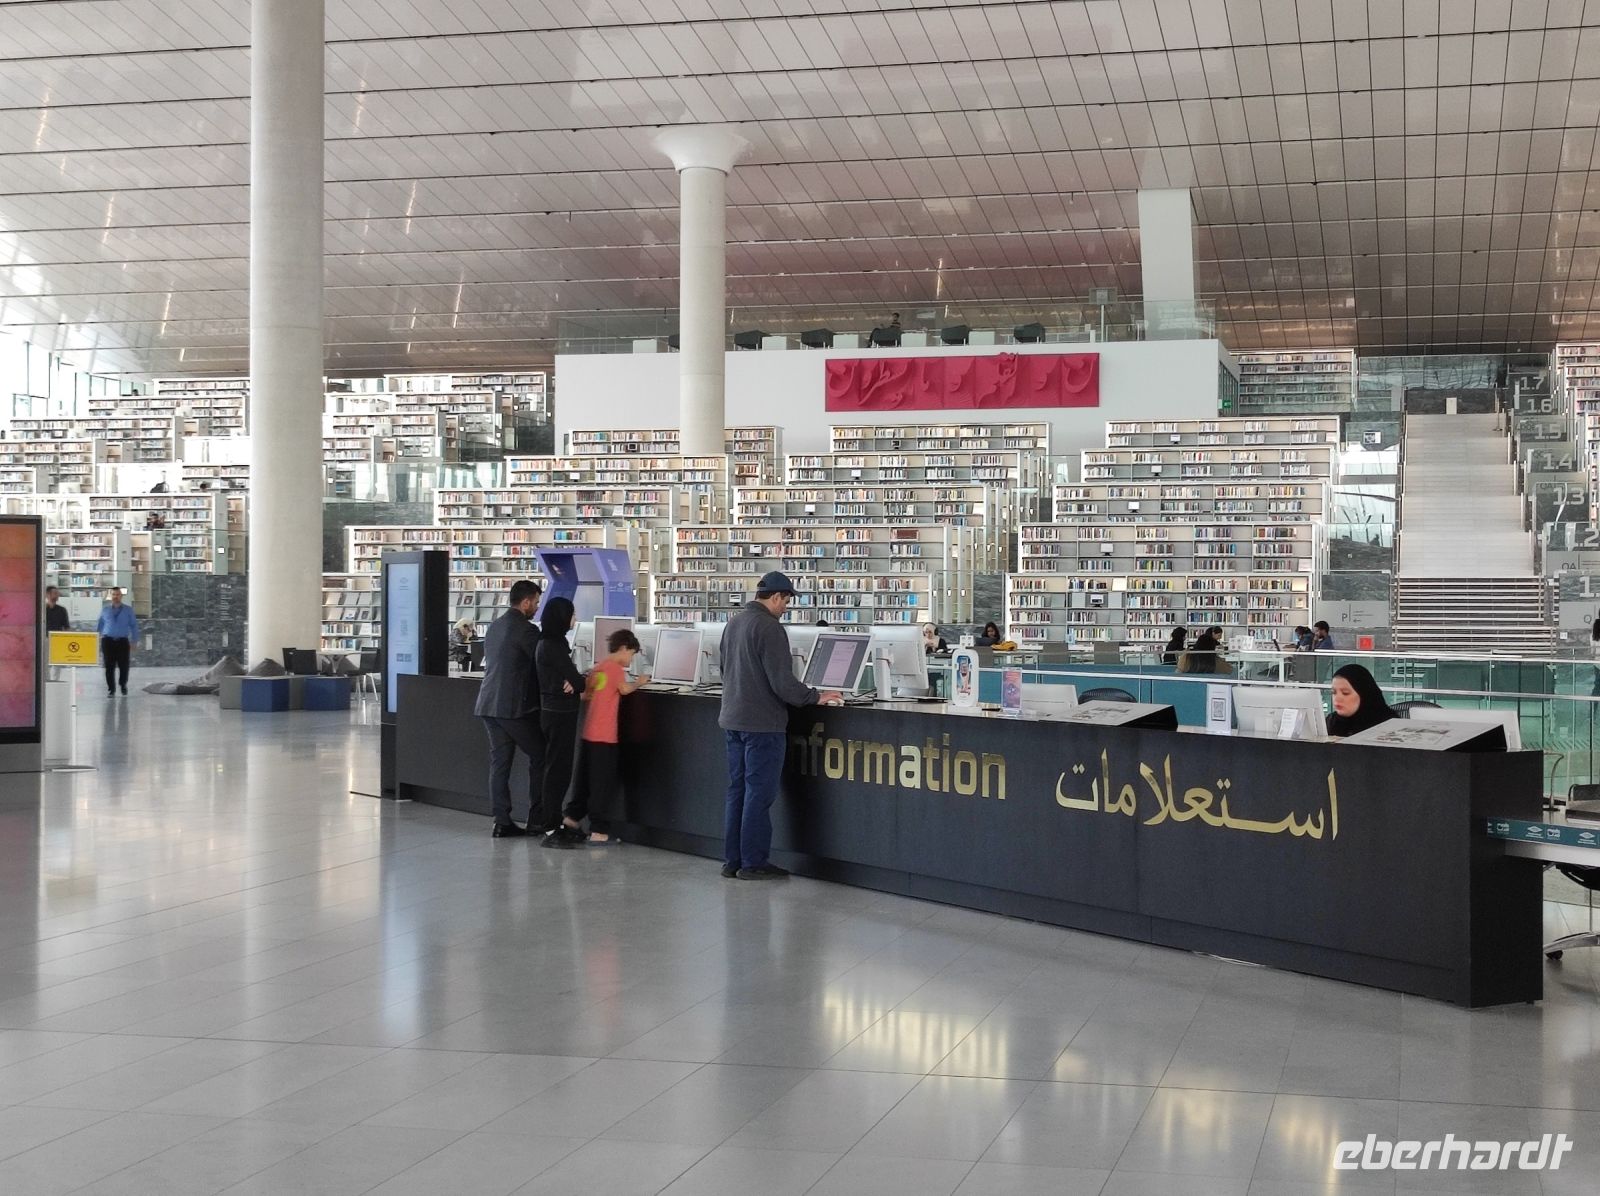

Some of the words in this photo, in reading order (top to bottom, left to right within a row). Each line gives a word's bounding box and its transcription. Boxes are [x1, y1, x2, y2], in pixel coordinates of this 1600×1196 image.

[1521, 376, 1545, 390] 1.7
[1527, 398, 1553, 413] 1.6
[1534, 423, 1562, 439] 1.5
[1543, 452, 1573, 470] 1.4
[1553, 487, 1585, 505] 1.3
[1580, 576, 1600, 598] 1.
[1583, 614, 1593, 625] Q
[791, 722, 1006, 800] nformation
[1055, 747, 1338, 841] استعلامات
